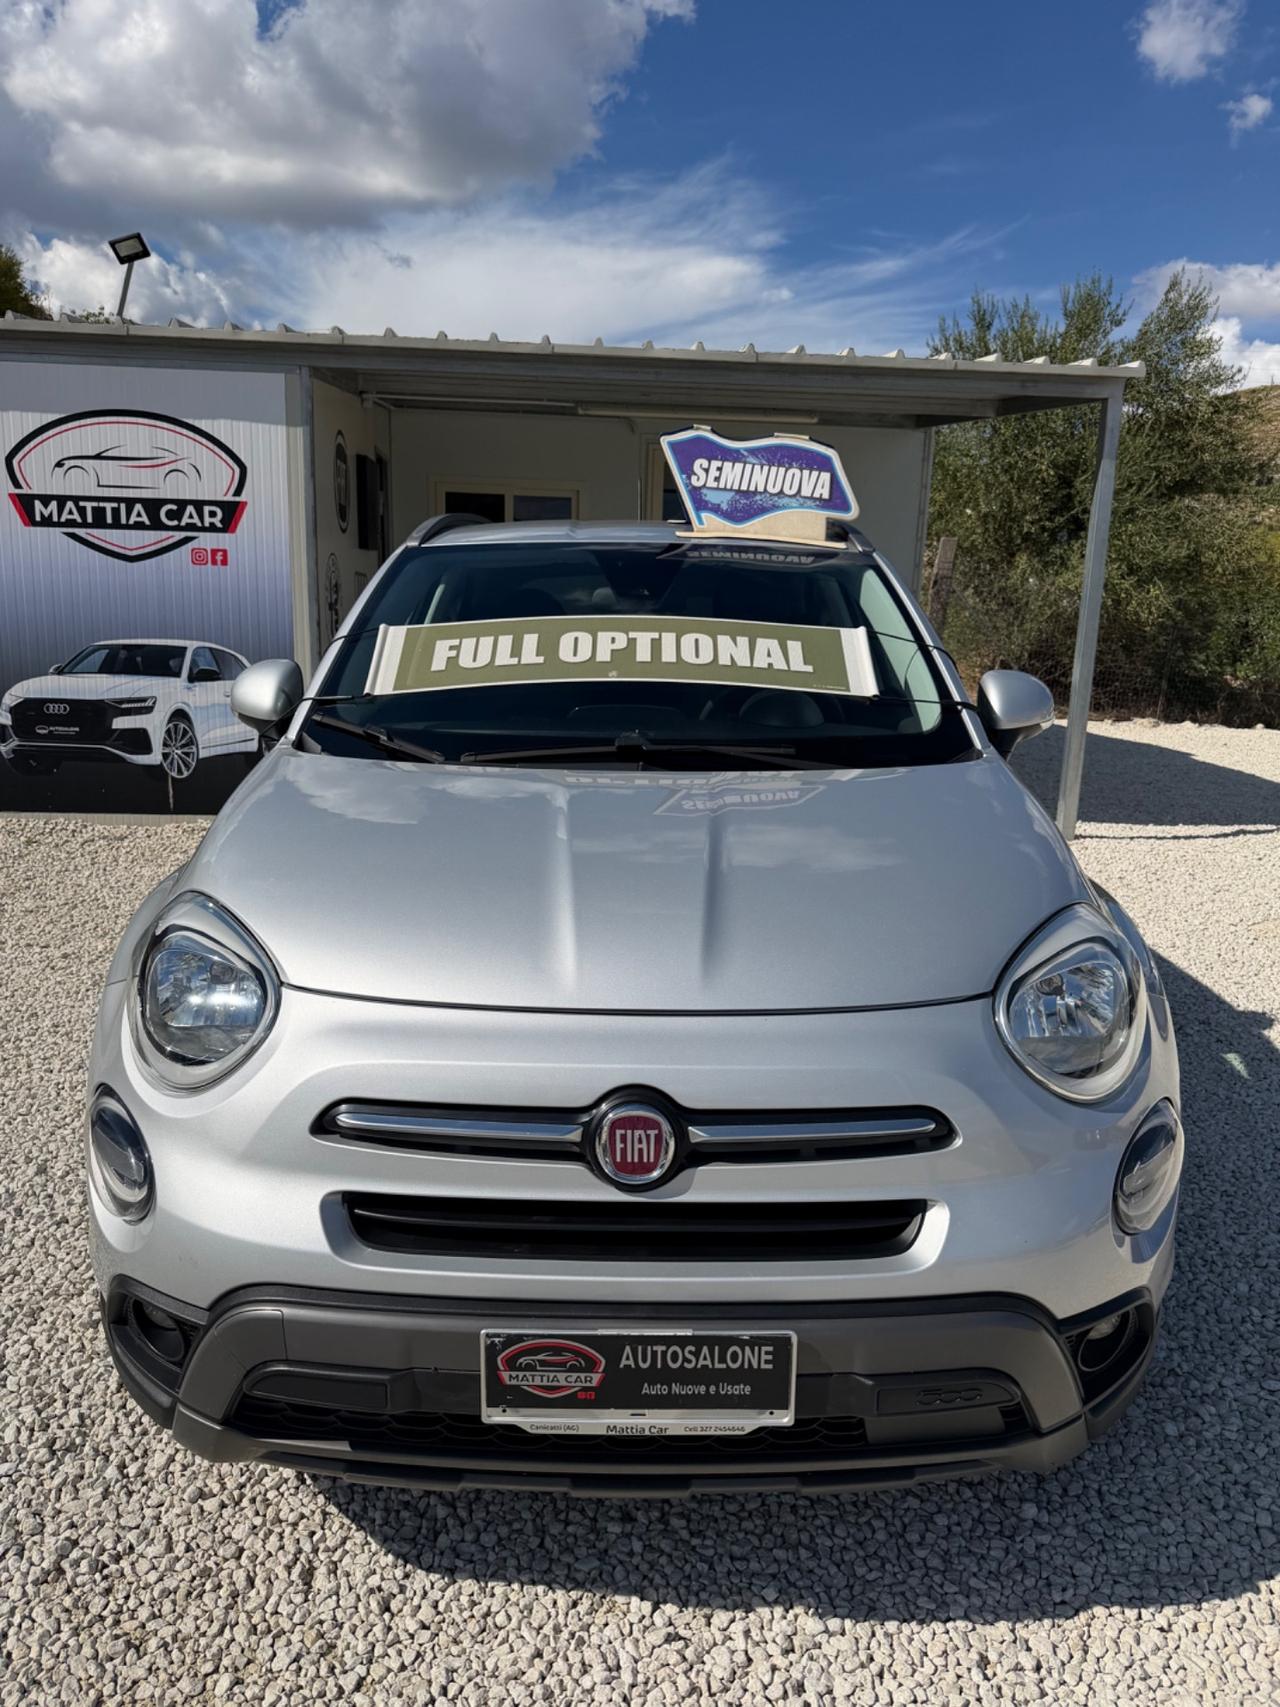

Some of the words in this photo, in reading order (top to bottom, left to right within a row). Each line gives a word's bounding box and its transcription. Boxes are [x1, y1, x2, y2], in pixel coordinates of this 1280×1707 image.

[690, 458, 832, 500] SEMINUOVA
[34, 499, 151, 526] MATTIA
[160, 503, 224, 529] CAR
[430, 632, 545, 672] FULL
[558, 631, 814, 673] OPTIONAL
[615, 1129, 659, 1163] FIAT
[619, 1345, 774, 1369] AUTOSALONE
[508, 1373, 560, 1384] MATTIA
[564, 1374, 594, 1385] CAR
[641, 1382, 668, 1395] Auto
[671, 1382, 706, 1395] Nuove
[709, 1385, 716, 1395] e
[719, 1382, 752, 1395] Usate
[606, 1424, 646, 1435] Mattia
[648, 1425, 670, 1435] Car
